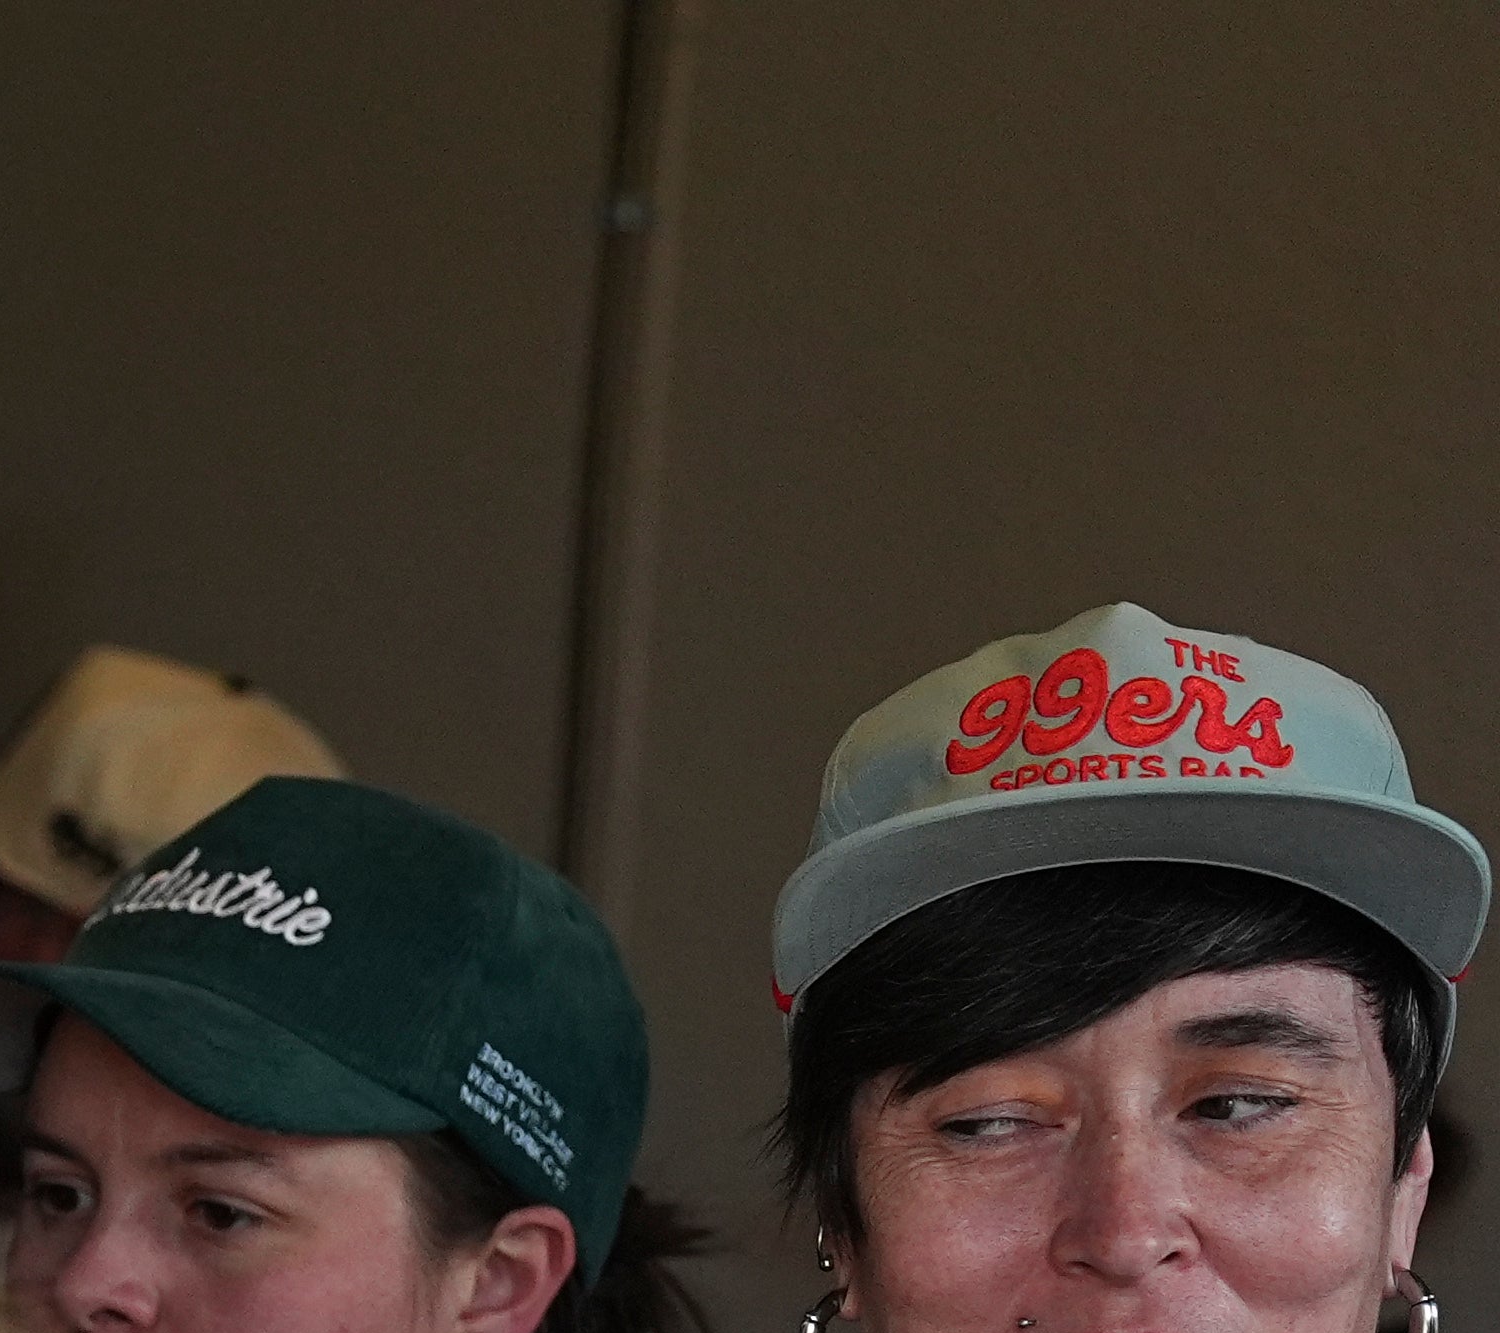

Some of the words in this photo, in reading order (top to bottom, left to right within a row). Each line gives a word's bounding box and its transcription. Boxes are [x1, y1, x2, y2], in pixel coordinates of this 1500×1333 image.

[1164, 637, 1246, 683] THE
[945, 647, 1294, 775] 99ers
[990, 754, 1168, 791] SPORTS
[84, 846, 333, 947] dustrie
